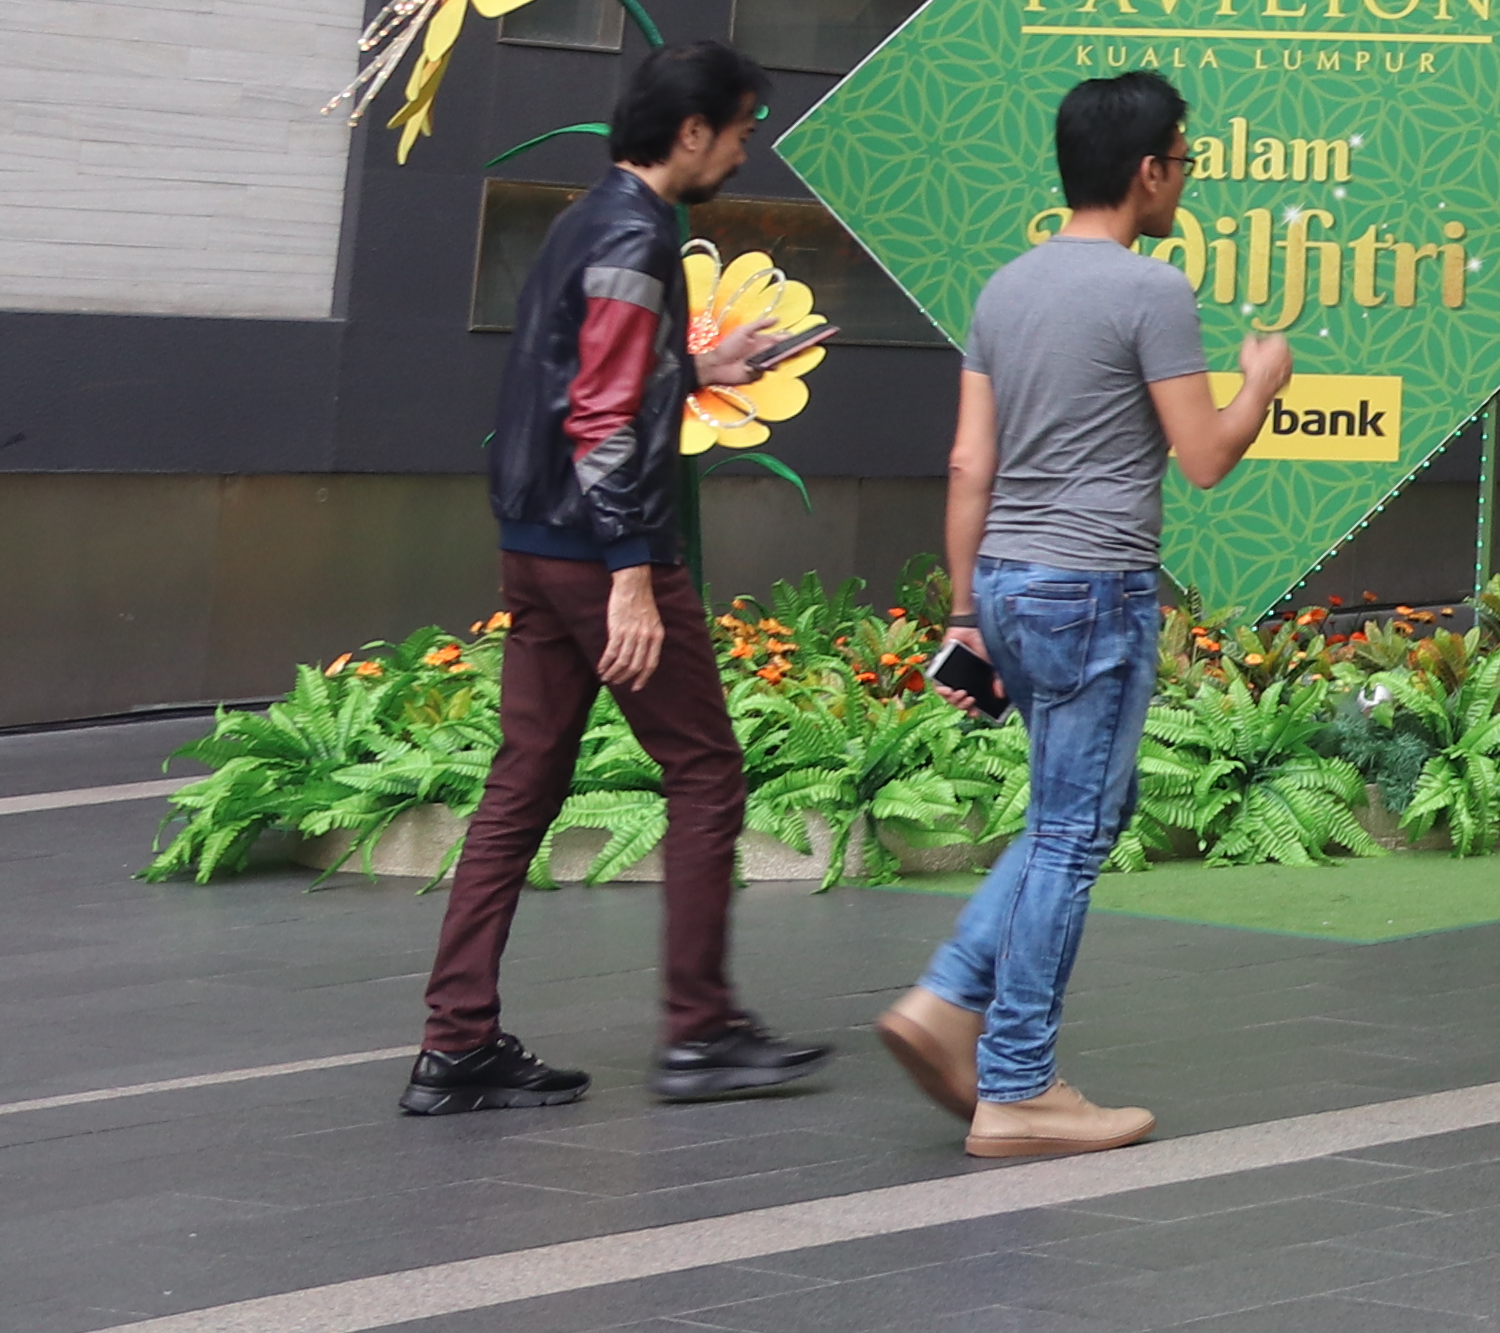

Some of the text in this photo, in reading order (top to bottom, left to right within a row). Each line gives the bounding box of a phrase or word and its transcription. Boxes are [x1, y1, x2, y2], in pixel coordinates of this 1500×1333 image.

[1076, 44, 1437, 75] KUALA LUMPUR
[1185, 117, 1353, 182] alam
[1027, 207, 1467, 332] dilfitri
[1256, 398, 1388, 437] bank
